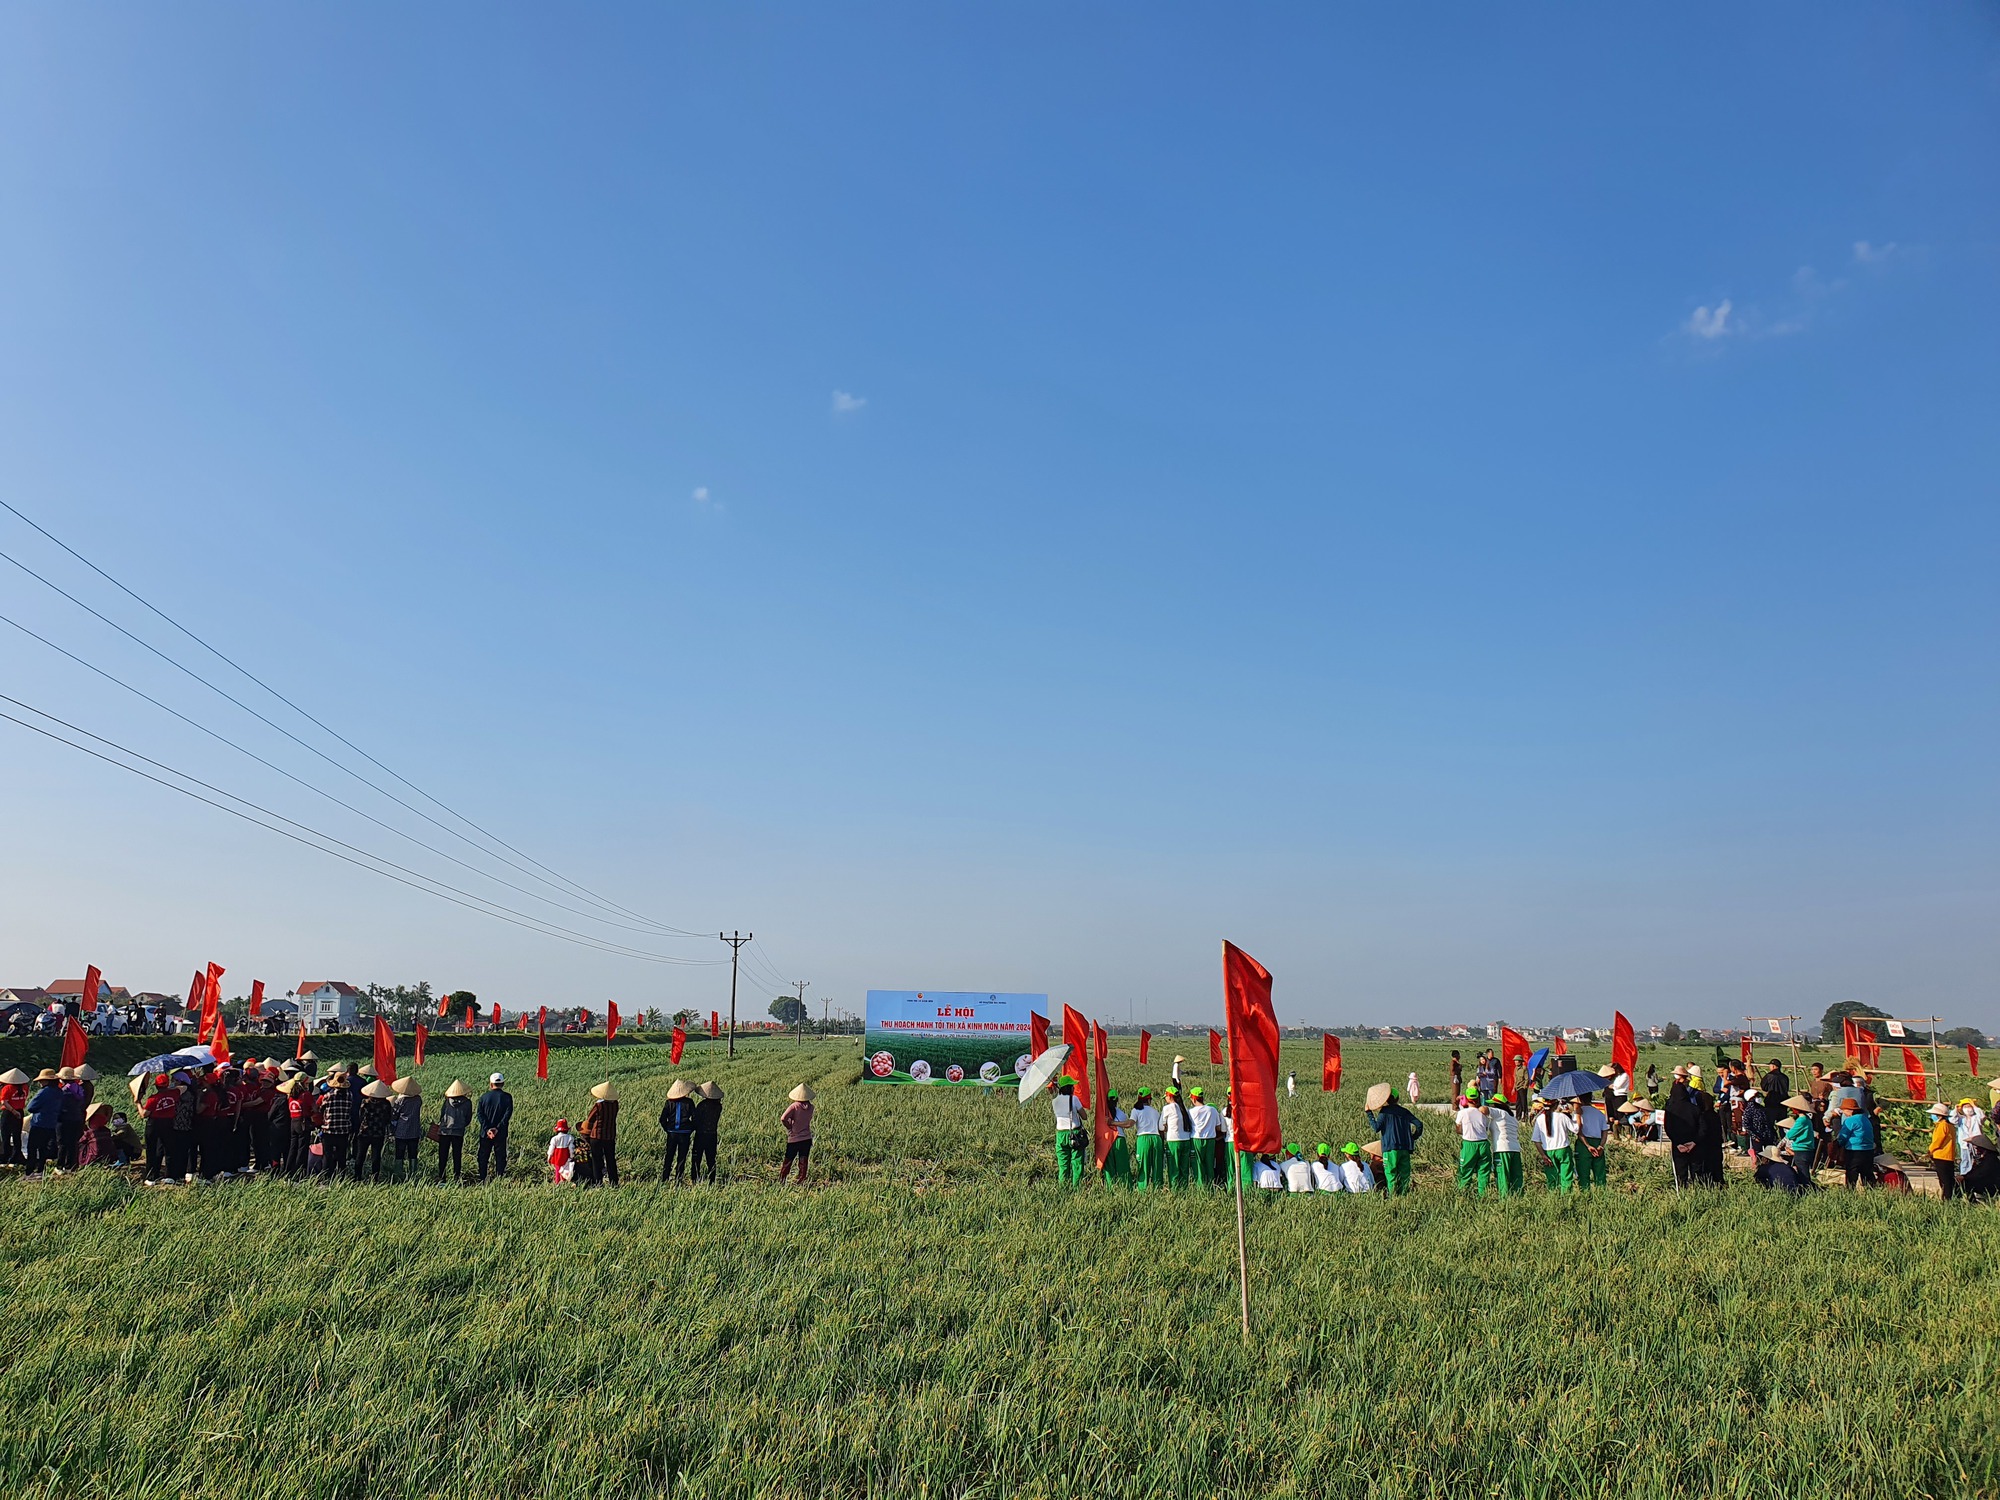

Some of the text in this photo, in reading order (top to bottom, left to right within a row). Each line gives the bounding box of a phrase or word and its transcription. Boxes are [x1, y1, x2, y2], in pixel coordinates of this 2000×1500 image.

[937, 1004, 975, 1019] LỄ HỘI
[881, 1020, 893, 1028] THU
[894, 1020, 915, 1030] HOẠCH
[946, 1021, 956, 1031] THỊ
[967, 1022, 983, 1031] KINH
[1000, 1021, 1015, 1031] NĂM
[1016, 1023, 1031, 1031] 2024
